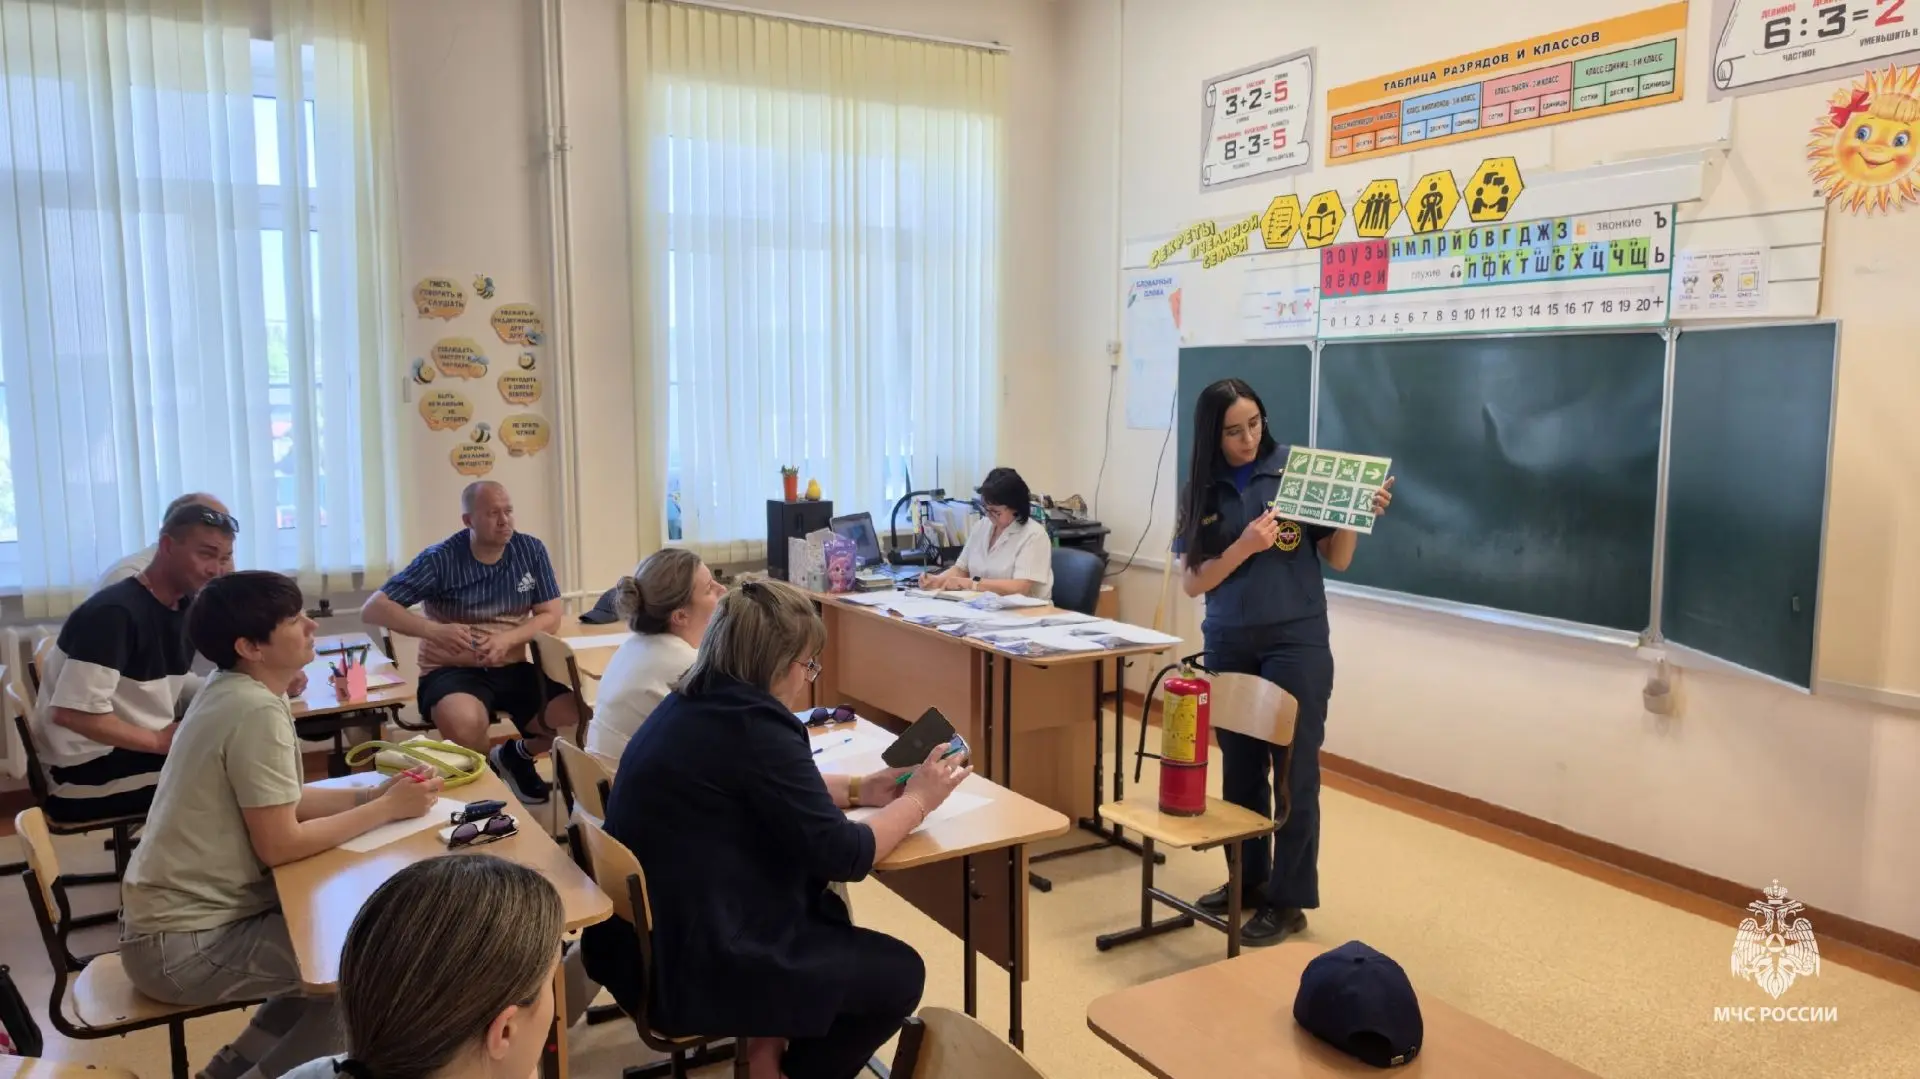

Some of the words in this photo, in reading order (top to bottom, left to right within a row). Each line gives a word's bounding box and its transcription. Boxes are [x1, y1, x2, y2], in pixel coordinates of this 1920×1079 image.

[1384, 71, 1436, 91] ТАБЛИЦА
[1443, 53, 1509, 77] РАЗРЯДОВ
[1517, 49, 1525, 60] И
[1533, 31, 1600, 56] КЛАССОВ
[1597, 218, 1642, 231] звонкие
[1150, 220, 1215, 270] СЕКРЕТЫ
[1201, 238, 1249, 270] СЕМЬИ
[1331, 316, 1336, 327] 0
[1344, 316, 1347, 326] 1
[1355, 316, 1360, 326] 2
[1368, 315, 1374, 326] 3
[1380, 314, 1386, 325] 4
[1393, 313, 1400, 324] 5
[1408, 312, 1414, 323] 6
[1422, 311, 1428, 321] 7
[1436, 310, 1443, 322] 8
[1451, 310, 1458, 321] 9
[1464, 308, 1475, 320] 10
[1481, 307, 1490, 319] 11
[1495, 306, 1506, 318] 12
[1512, 305, 1523, 317] 13
[1529, 304, 1541, 316] 14
[1547, 303, 1559, 315] 15
[1565, 303, 1576, 315] 16
[1582, 301, 1594, 314] 17
[1600, 300, 1613, 313] 18
[1619, 299, 1630, 312] 19
[1636, 298, 1651, 311] 20
